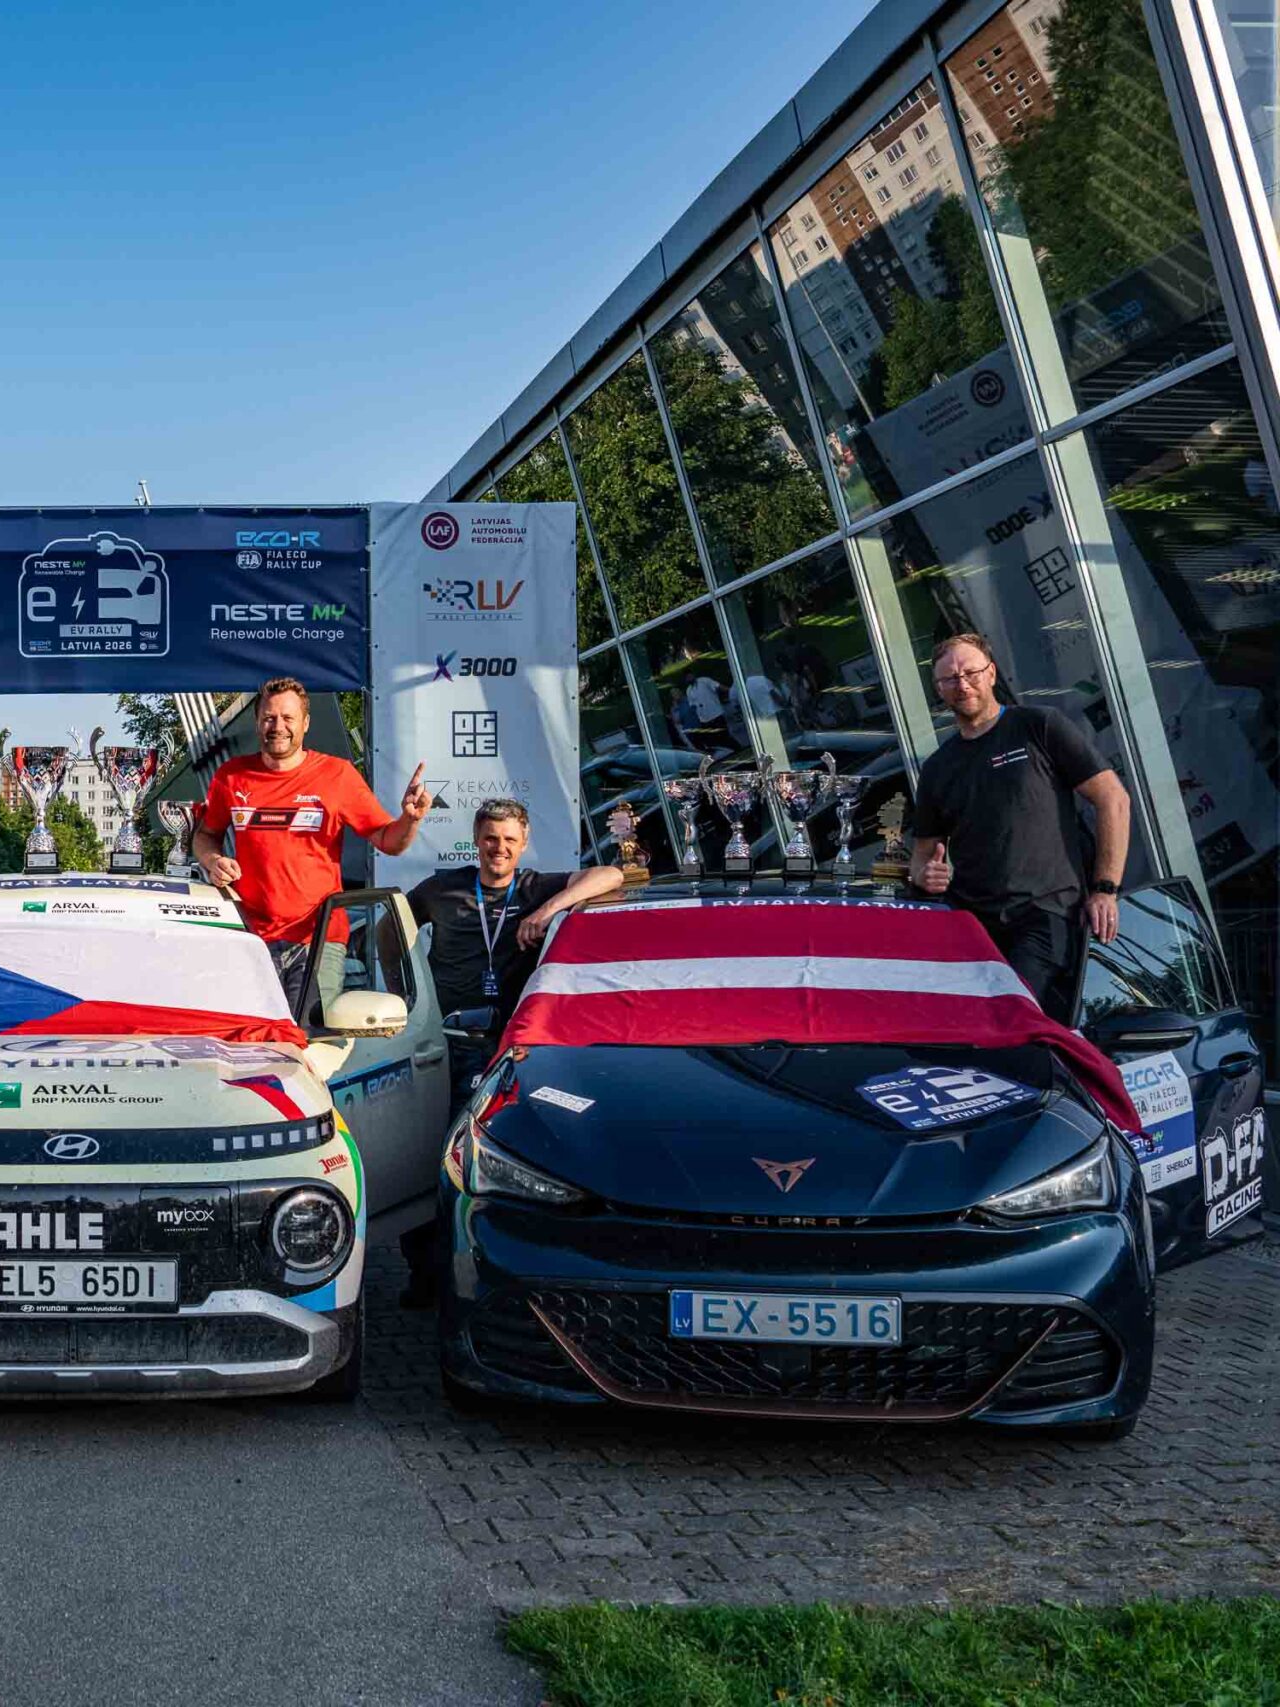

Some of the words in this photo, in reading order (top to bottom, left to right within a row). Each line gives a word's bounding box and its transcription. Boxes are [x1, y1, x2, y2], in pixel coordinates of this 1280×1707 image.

[267, 551, 282, 559] FIA
[286, 551, 306, 559] ECO
[267, 560, 298, 569] RALLY
[301, 560, 322, 569] CUP
[312, 605, 346, 621] MY
[71, 626, 84, 635] EV
[89, 626, 123, 635] RALLY
[211, 628, 287, 640] Renewable
[293, 628, 344, 642] Charge
[61, 641, 101, 651] LATVIA
[105, 641, 133, 651] 2026
[438, 853, 480, 861] MOTOR
[81, 880, 166, 889] LATVIA
[52, 902, 100, 910] ARVAL
[160, 909, 222, 917] TYRES
[33, 1085, 116, 1095] ARVAL
[119, 1096, 164, 1104] GROUP
[941, 1107, 983, 1121] LATVIA
[36, 1304, 68, 1312] HYUNDAI
[675, 1319, 691, 1329] LV
